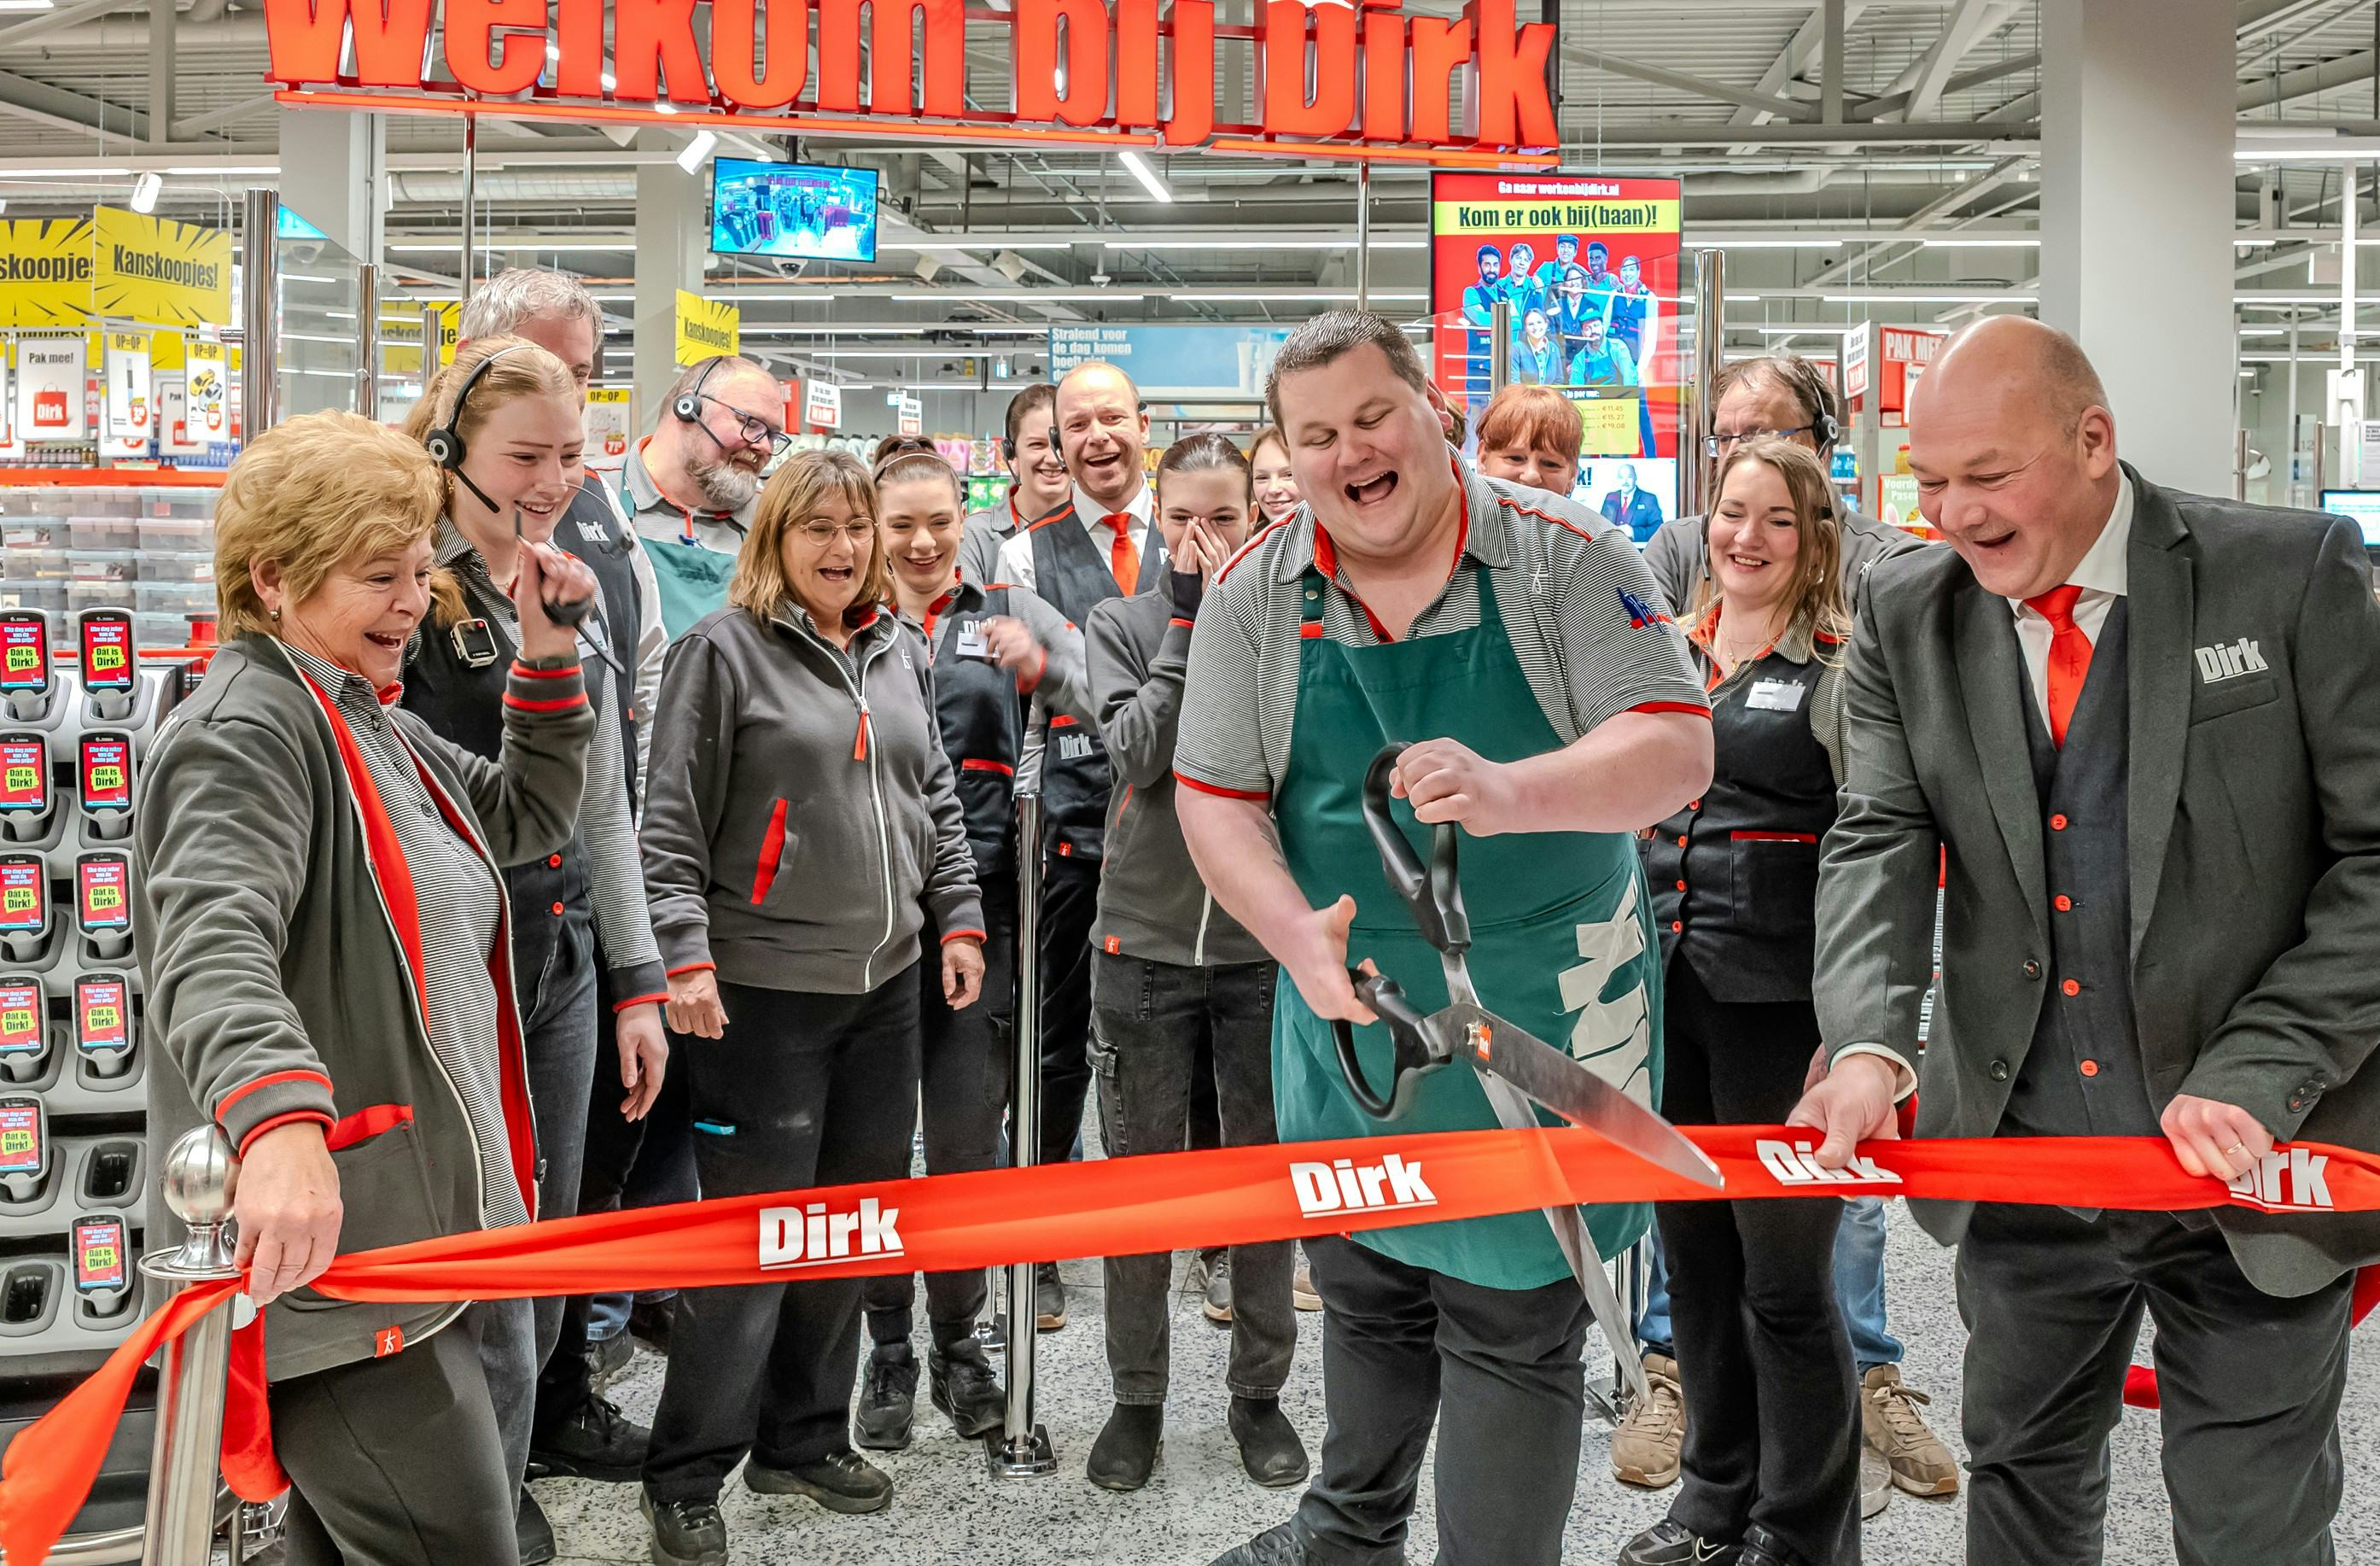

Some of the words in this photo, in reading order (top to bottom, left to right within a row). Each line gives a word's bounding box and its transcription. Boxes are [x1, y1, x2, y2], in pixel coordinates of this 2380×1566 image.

[265, 0, 965, 118] Welkom
[1011, 0, 1215, 147] bij
[1265, 0, 1560, 149] Dirk
[1498, 181, 1513, 194] Ga
[1514, 183, 1537, 194] naar
[1459, 207, 1499, 227] Kom
[1505, 209, 1524, 226] er
[1529, 207, 1562, 226] ook
[114, 244, 219, 289] Kanskoopjes!
[684, 317, 732, 349] Kanskoopjes!
[1052, 327, 1100, 341] Stralend
[1102, 330, 1128, 341] voor
[1053, 342, 1067, 354] de
[1070, 342, 1091, 355] dag
[1094, 342, 1133, 355] komen
[1885, 332, 1913, 359] PAK
[29, 353, 46, 364] Pak
[49, 353, 74, 364] mee!
[37, 404, 64, 420] Dirk
[576, 521, 610, 541] Dirk
[26, 648, 32, 657] is
[112, 647, 119, 656] is
[11, 657, 33, 667] Dirk!
[96, 657, 120, 666] Dirk!
[2194, 637, 2269, 681] Dirk
[1059, 733, 1094, 760] Dirk
[110, 768, 118, 776] is
[10, 778, 32, 787] Dirk!
[96, 777, 118, 786] Dirk!
[23, 890, 30, 898] is
[9, 899, 31, 909] Dirk!
[94, 897, 116, 906] Dirk!
[6, 1021, 29, 1031] Dirk!
[91, 1017, 114, 1026] Dirk!
[6, 1141, 28, 1150] Dirk!
[1289, 1153, 1437, 1212] Dirk
[2226, 1148, 2334, 1207] rk
[759, 1197, 905, 1266] Dirk
[90, 1258, 112, 1267] Dirk!
